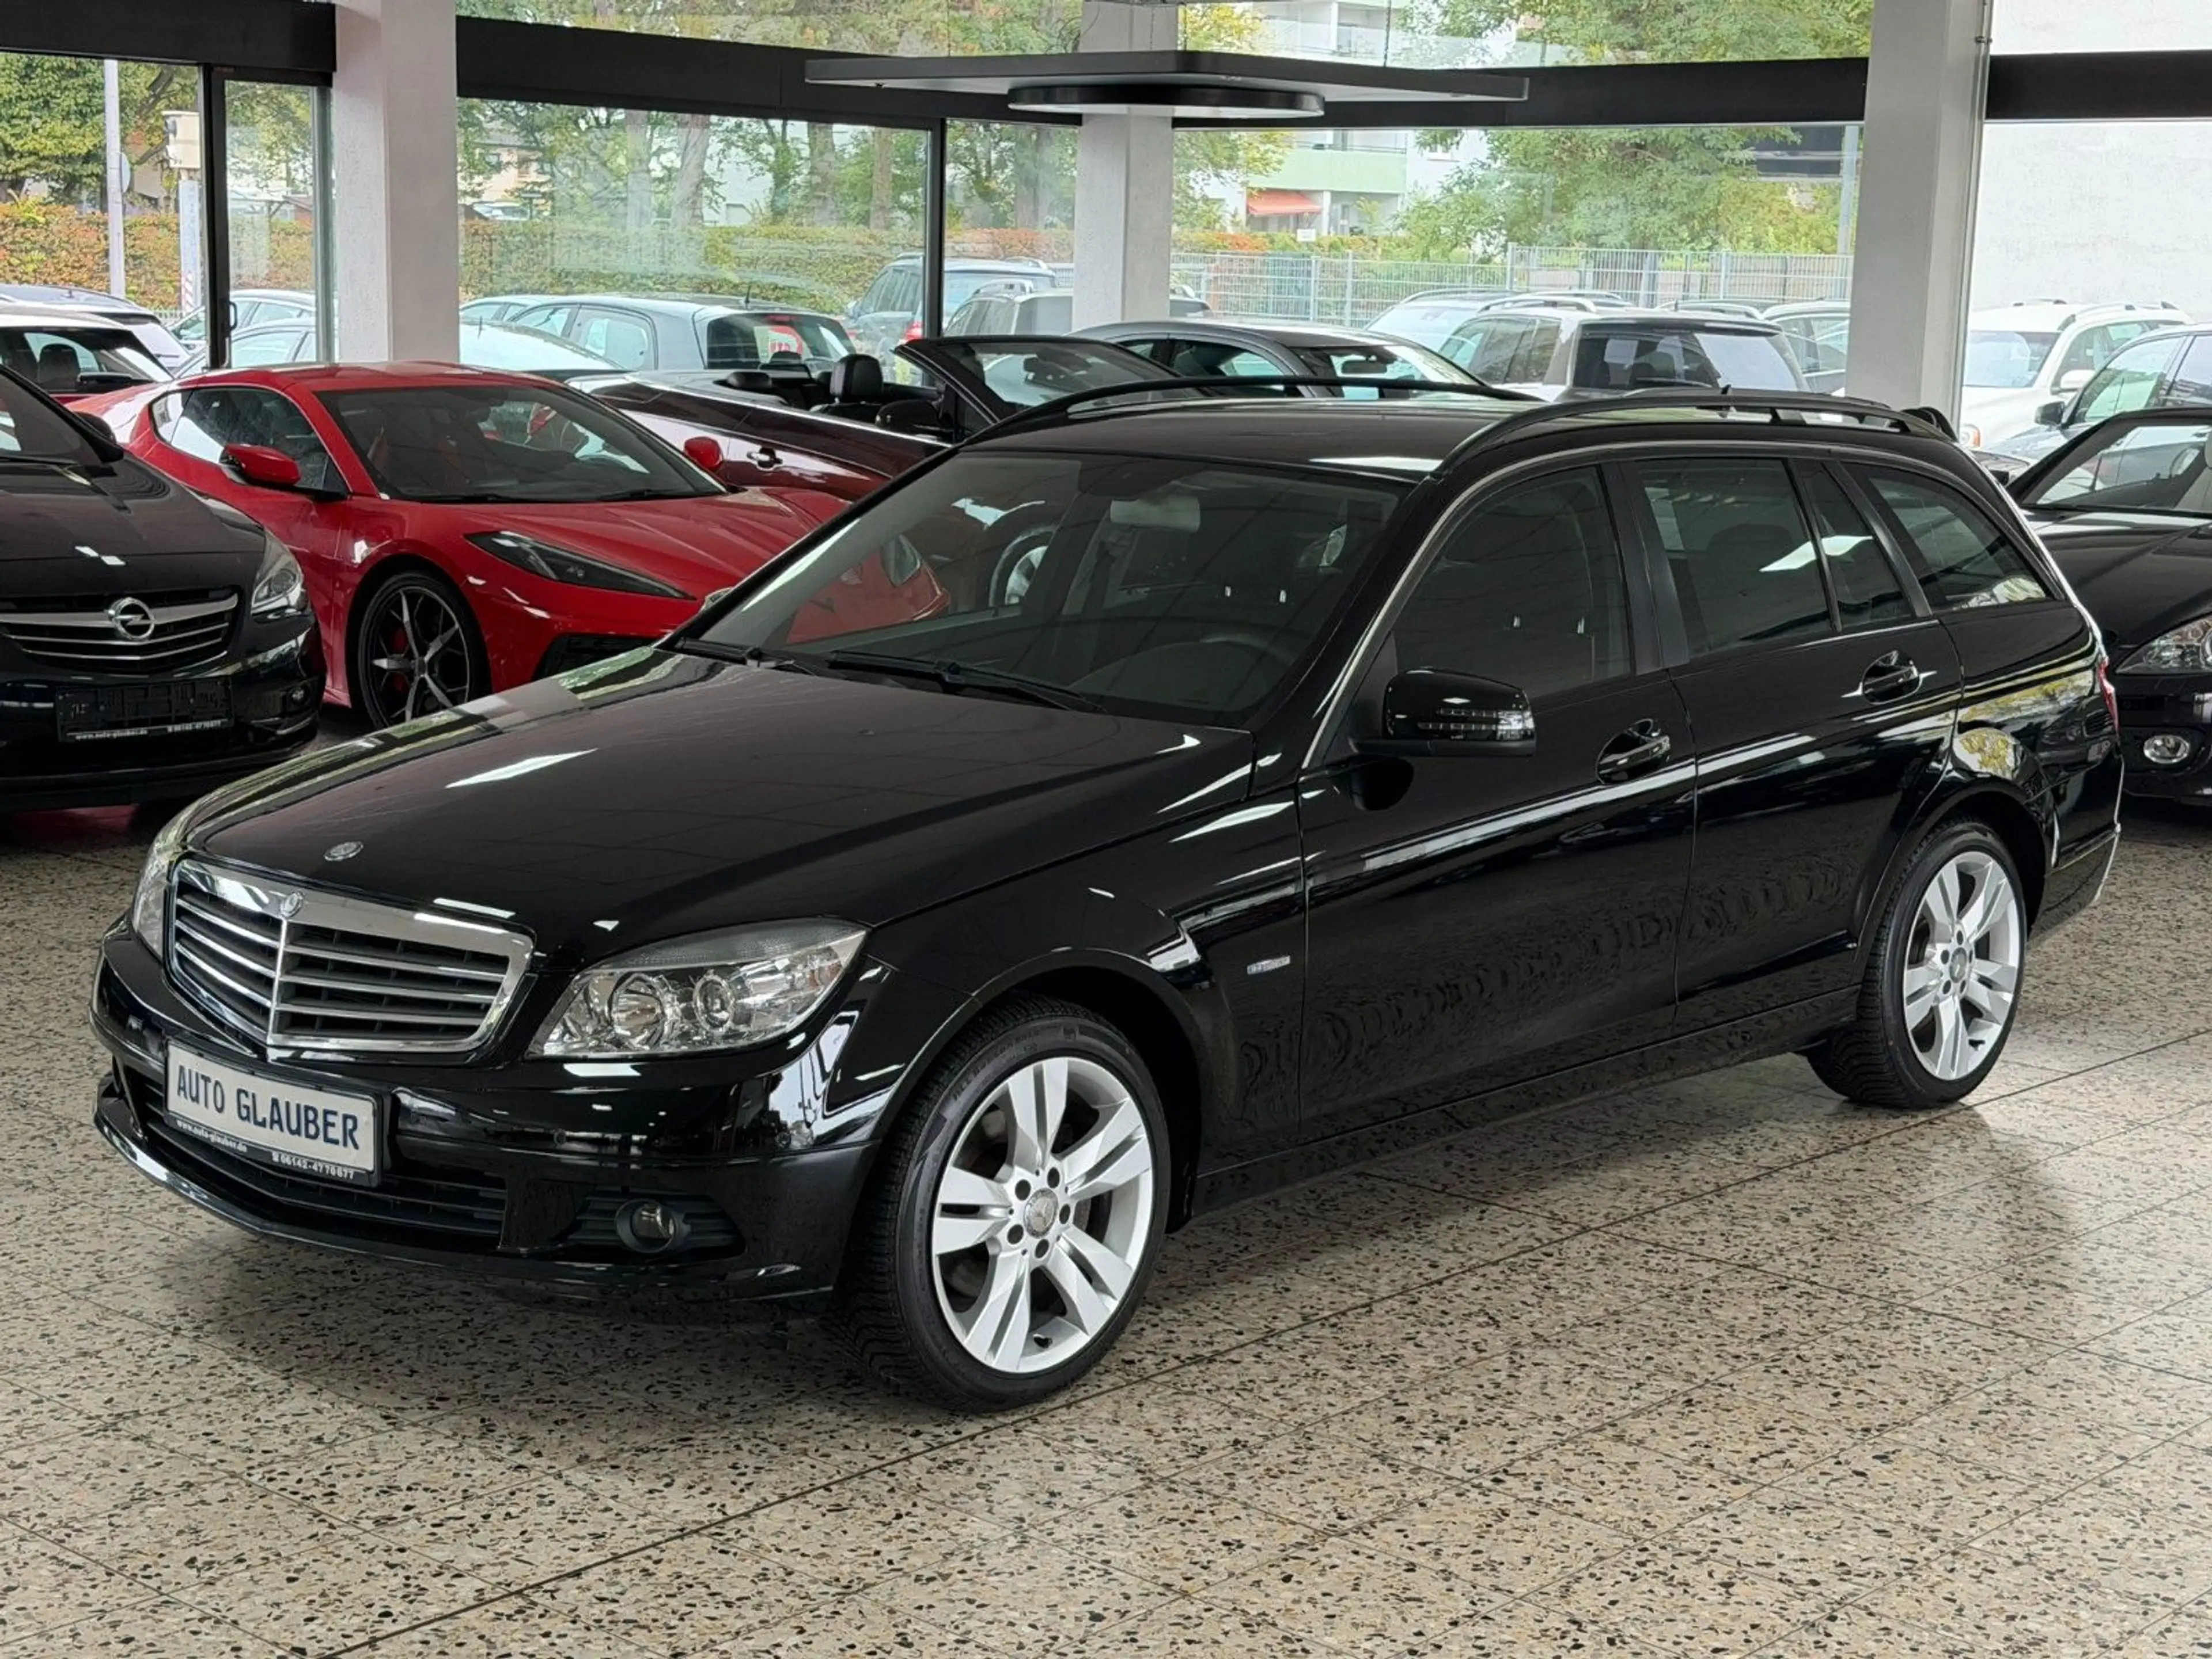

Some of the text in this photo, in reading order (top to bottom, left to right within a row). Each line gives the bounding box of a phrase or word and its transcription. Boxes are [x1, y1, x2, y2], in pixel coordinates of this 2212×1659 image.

[176, 1119, 248, 1153] www.auto-glauber.de
[177, 1065, 359, 1150] AUTO GLAUBER
